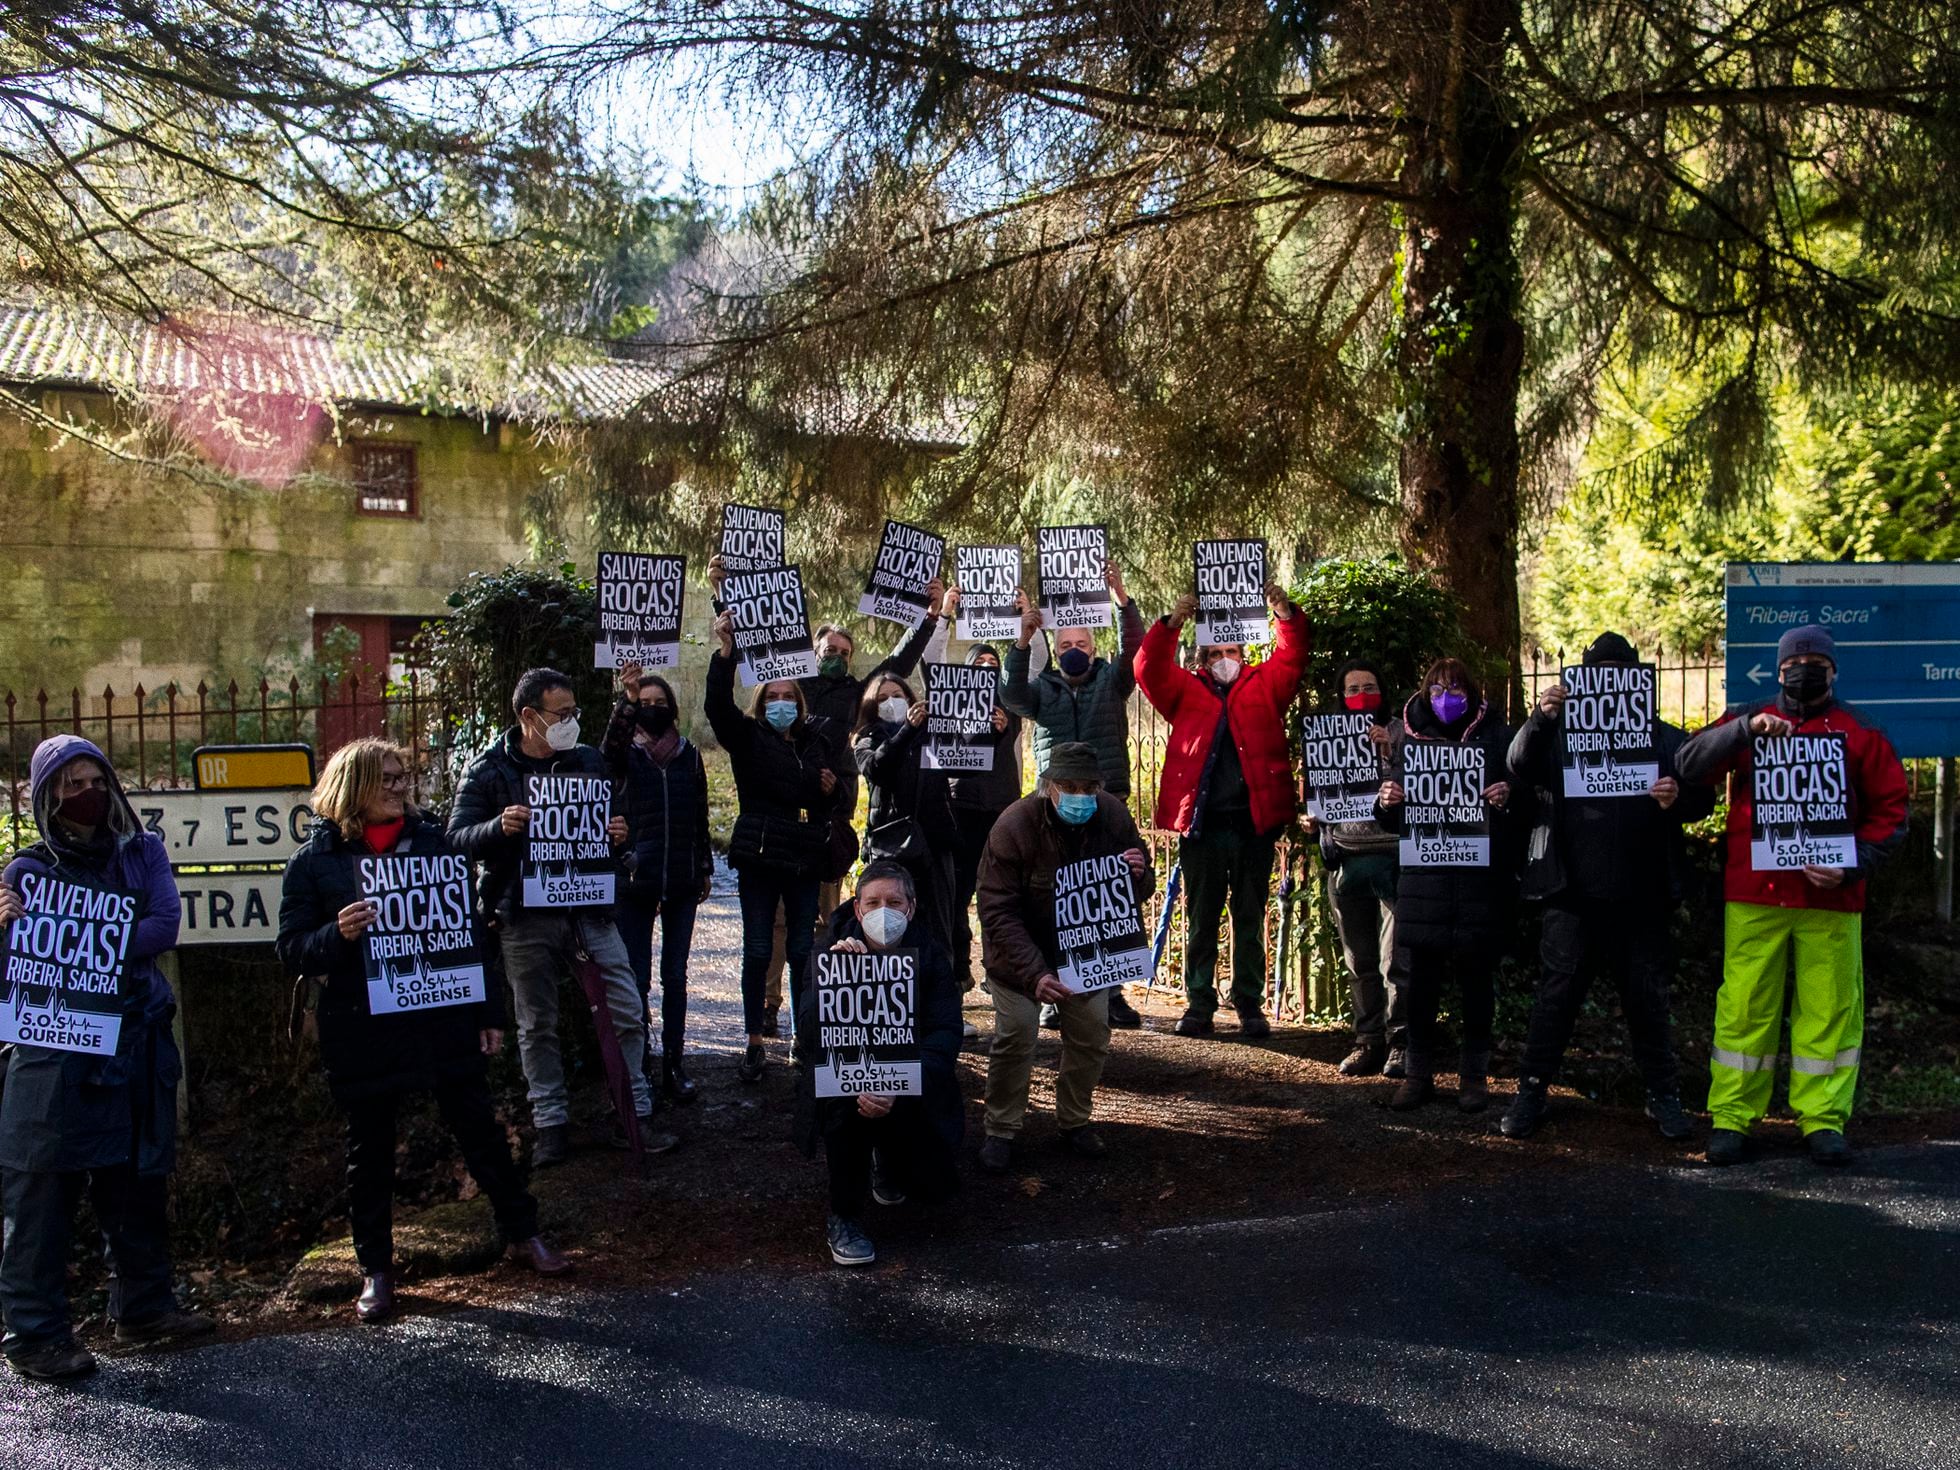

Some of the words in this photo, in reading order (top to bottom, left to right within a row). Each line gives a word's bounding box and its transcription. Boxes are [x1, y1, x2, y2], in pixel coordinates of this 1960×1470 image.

[725, 505, 782, 531] SALVEMOS
[721, 530, 782, 561] ROCAS!
[885, 522, 943, 556] SALVEMOS
[1040, 529, 1104, 552] SALVEMOS
[958, 547, 1018, 569] SALVEMOS
[1041, 546, 1105, 578] ROCAS!
[1197, 542, 1262, 566] SALVEMOS
[602, 554, 682, 580] SALVEMOS
[1198, 561, 1263, 594] ROCAS!
[725, 570, 799, 602] SALVEMOS
[873, 570, 904, 590] RIBEIRA
[958, 565, 1018, 595] ROCAS!
[1043, 580, 1075, 595] RIBEIRA
[1078, 579, 1106, 592] SACRA
[601, 580, 680, 616] ROCAS!
[728, 588, 804, 629] ROCAS!
[877, 599, 900, 610] S.O.S
[960, 594, 990, 608] RIBEIRA
[1200, 595, 1233, 610] RIBEIRA
[1236, 594, 1264, 607] SACRA
[601, 612, 641, 631] RIBEIRA
[644, 616, 676, 631] SACRA
[874, 607, 917, 624] OURENSE
[1057, 608, 1082, 618] S.O.S
[1057, 616, 1103, 626] OURENSE
[1746, 606, 1809, 623] "Ribeira
[1818, 605, 1879, 623] Sacra"
[972, 629, 1015, 638] OURENSE
[973, 621, 995, 630] S.O.S
[1214, 625, 1240, 634] S.O.S
[735, 628, 772, 649] RIBEIRA
[775, 624, 807, 642] SACRA
[1214, 632, 1261, 643] OURENSE
[616, 656, 669, 667] ORENSE
[617, 648, 646, 658] S.O.S
[756, 658, 783, 672] S.O.S
[757, 665, 808, 682] OURENSE
[930, 665, 995, 689] SALVEMOS
[1565, 667, 1652, 696] SALVEMOS
[929, 689, 995, 722] ROCAS!
[1565, 691, 1652, 732] ROCAS!
[928, 718, 960, 733] RIBEIRA
[963, 721, 991, 733] SACRA
[1303, 714, 1374, 740] SALVEMOS
[1306, 734, 1378, 768] ROCAS!
[1567, 733, 1610, 752] RIBEIRA
[1614, 733, 1652, 749] SACRA
[1754, 737, 1844, 767] SALVEMOS
[938, 759, 984, 767] OURENSE
[1404, 744, 1485, 772] SALVEMOS
[200, 758, 228, 785] OR
[1309, 770, 1344, 786] RIBEIRA
[1346, 768, 1379, 783] SACRA
[1587, 770, 1619, 782] S.O.S
[1755, 760, 1847, 803] ROCAS!
[528, 776, 611, 806] SALVEMOS
[1404, 768, 1485, 807] ROCAS!
[1587, 781, 1648, 793] OURENSE
[1326, 801, 1353, 811] S.O.S
[1405, 806, 1445, 824] RIBEIRA
[1449, 807, 1484, 822] SACRA
[1757, 804, 1804, 824] RIBEIRA
[1807, 803, 1847, 820] SACRA
[529, 801, 610, 842] ROCAS!
[530, 842, 573, 861] RIBEIRA
[577, 842, 610, 859] SACRA
[1421, 852, 1479, 863] OURENSE
[1422, 842, 1452, 852] S.O.S
[1777, 843, 1813, 855] S.O.S
[1777, 853, 1844, 867] OURENSE
[360, 855, 468, 894] SALVEMOS
[1055, 854, 1129, 896] SALVEMOS
[20, 872, 135, 922] SALVEMOS
[547, 890, 604, 903] OURENSE
[548, 881, 580, 892] S.O.S
[364, 879, 472, 932] ROCAS!
[1056, 875, 1138, 928] ROCAS!
[370, 934, 424, 960] RIBEIRA
[428, 930, 473, 952] SACRA
[1058, 925, 1101, 951] RIBEIRA
[1102, 918, 1140, 939] SACRA
[10, 916, 131, 975] ROCAS!
[6, 956, 62, 988] RIBEIRA
[68, 969, 118, 994] SACRA
[818, 953, 914, 986] SALVEMOS
[1082, 961, 1114, 977] S.O.S
[1083, 965, 1143, 989] OURENSE
[397, 978, 436, 994] S.O.S
[397, 986, 471, 1008] OURENSE
[818, 980, 914, 1026] ROCAS!
[22, 1012, 66, 1030] S.O.S
[18, 1027, 102, 1048] OURENSE
[821, 1027, 869, 1048] RIBEIRA
[873, 1027, 914, 1045] SACRA
[841, 1068, 878, 1081] S.O.S
[841, 1080, 909, 1093] OURENSE
